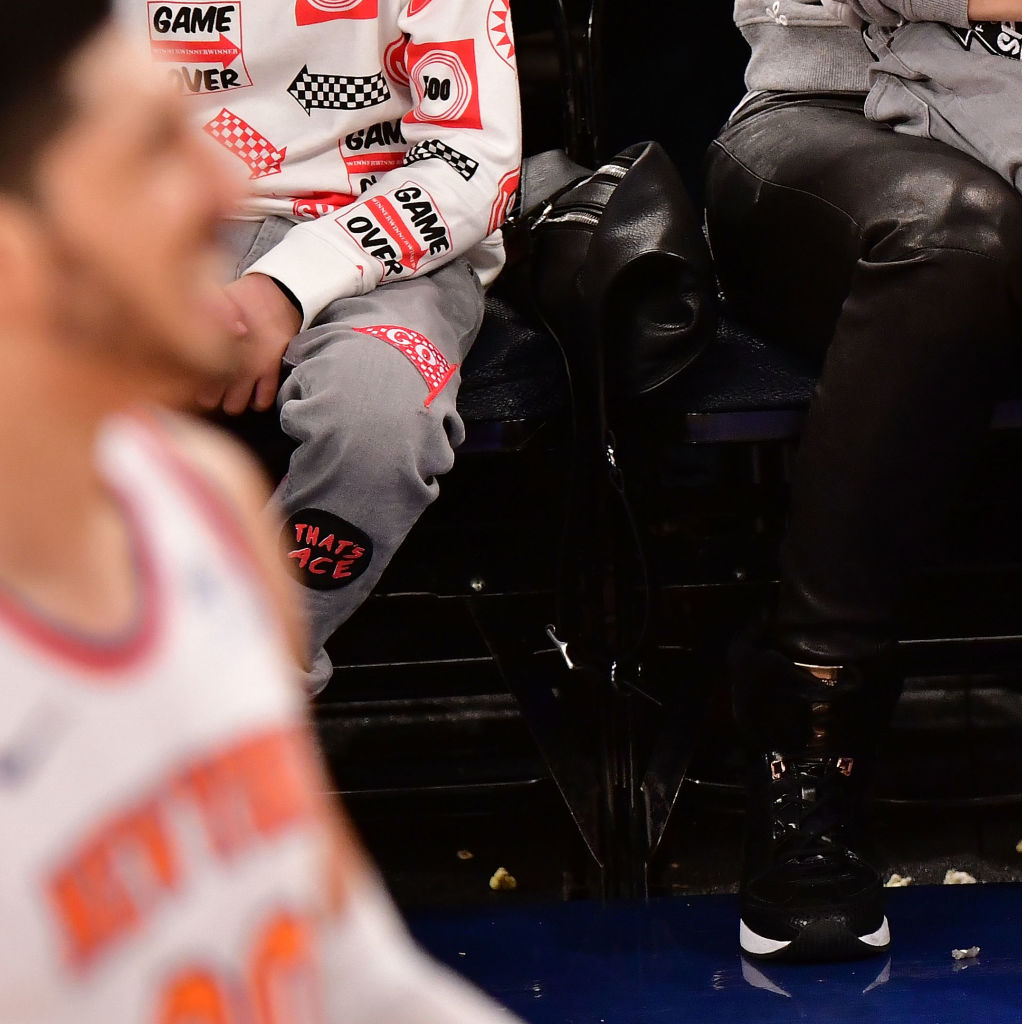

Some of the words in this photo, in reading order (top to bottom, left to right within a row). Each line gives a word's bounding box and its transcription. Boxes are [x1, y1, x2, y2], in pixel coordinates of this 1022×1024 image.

[153, 5, 235, 34] GAME
[394, 187, 450, 256] GAME
[346, 216, 403, 277] OVER
[295, 523, 365, 559] THAT'S
[287, 547, 355, 579] ACE
